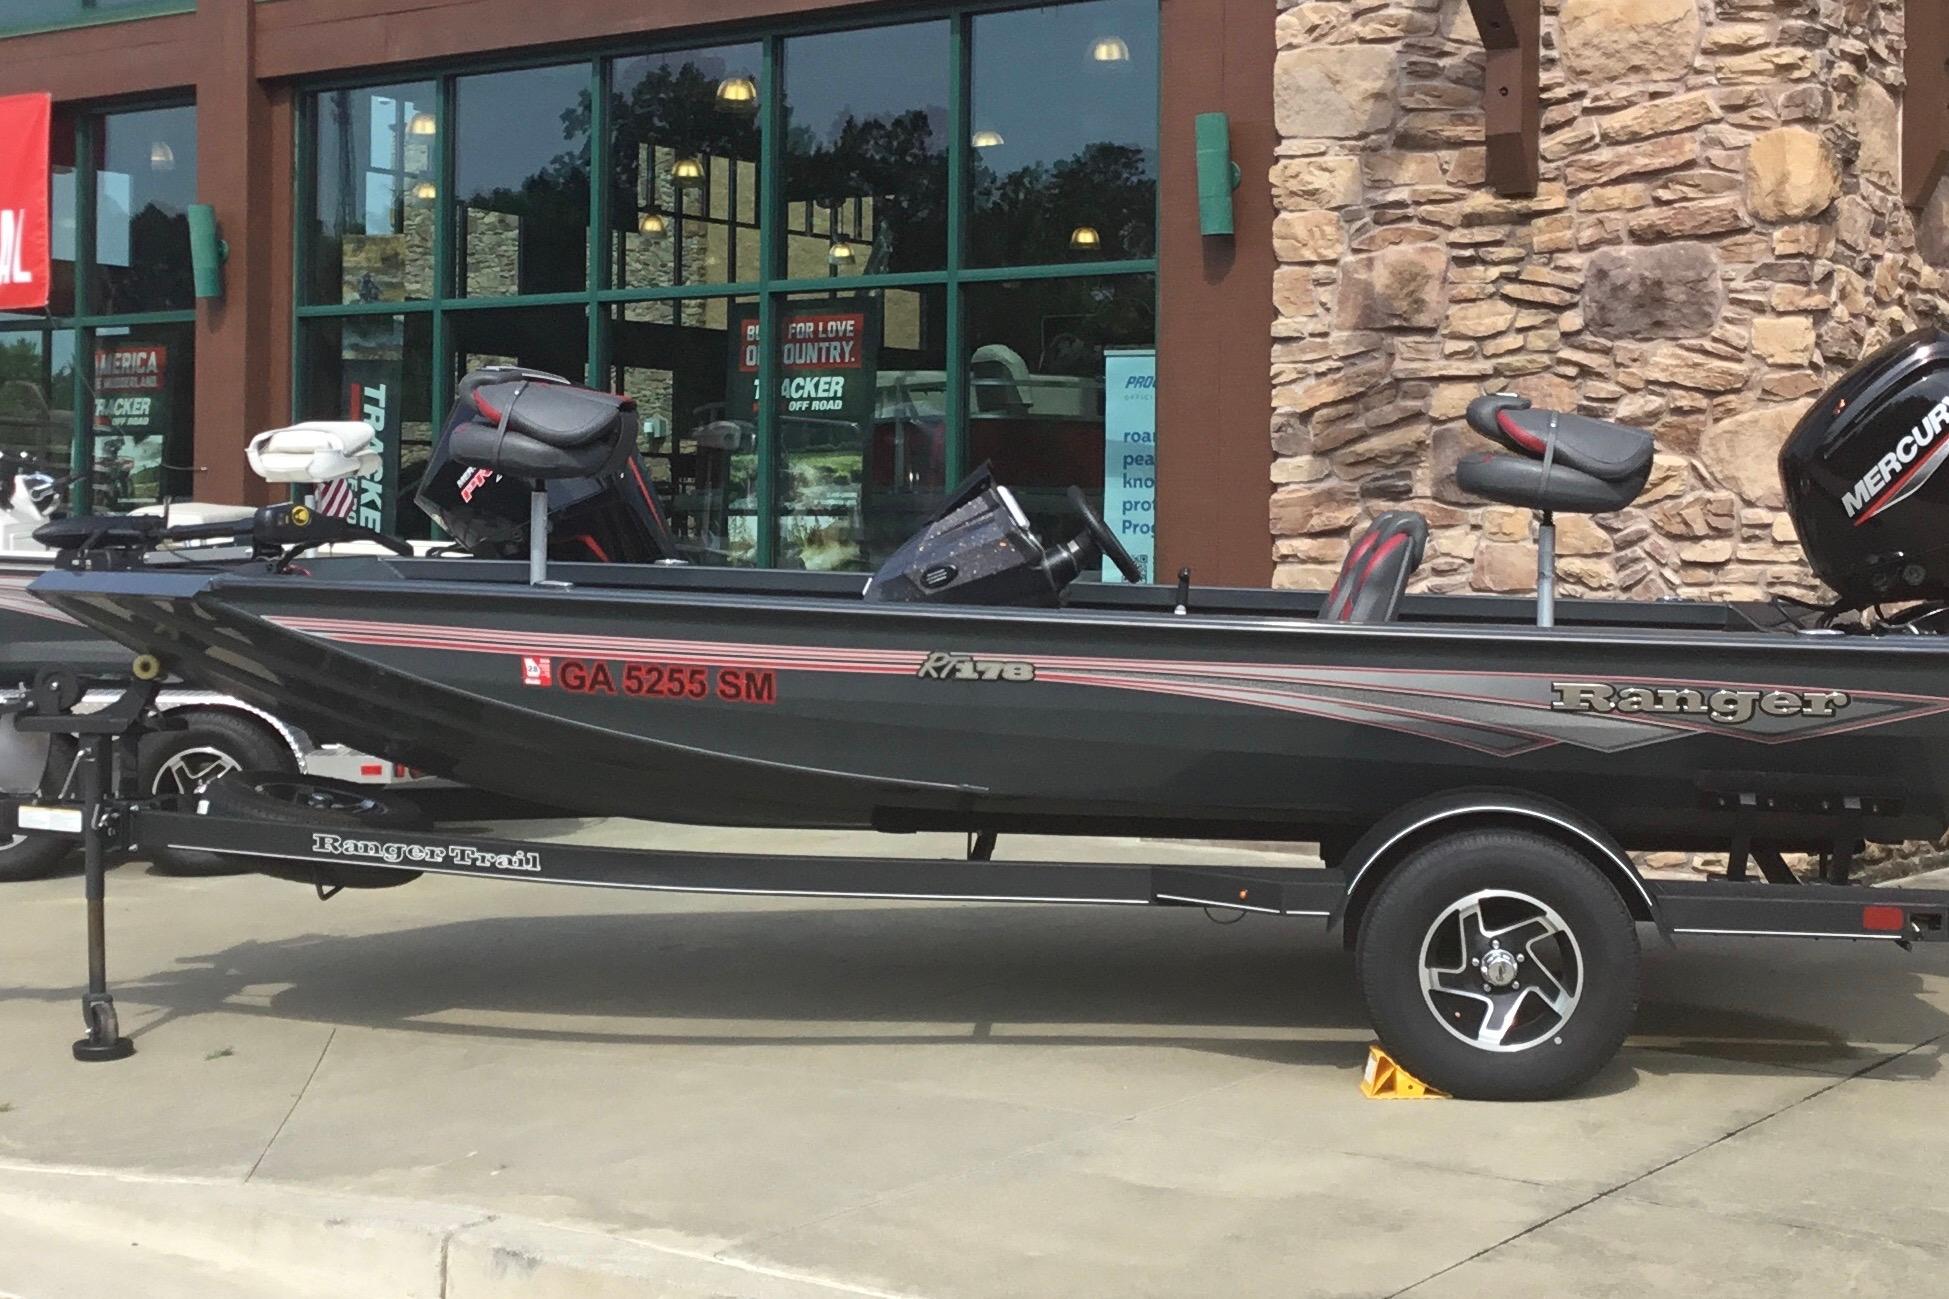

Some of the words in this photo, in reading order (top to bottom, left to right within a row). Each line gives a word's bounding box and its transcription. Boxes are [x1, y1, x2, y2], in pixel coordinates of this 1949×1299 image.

[788, 322, 814, 339] FOR
[819, 320, 855, 338] LOVE
[95, 351, 158, 374] MERICA
[783, 340, 856, 365] OUNTRY.
[1125, 375, 1155, 389] PRO
[95, 398, 151, 416] RACKER
[788, 401, 812, 412] OFF
[811, 400, 842, 411] ROAD
[1122, 500, 1155, 516] pro
[559, 659, 617, 694] GA
[623, 661, 708, 701] 5255
[718, 667, 776, 704] SM
[1550, 681, 1850, 724] Ranger
[312, 833, 446, 863] Ranger
[449, 845, 542, 872] Trail
